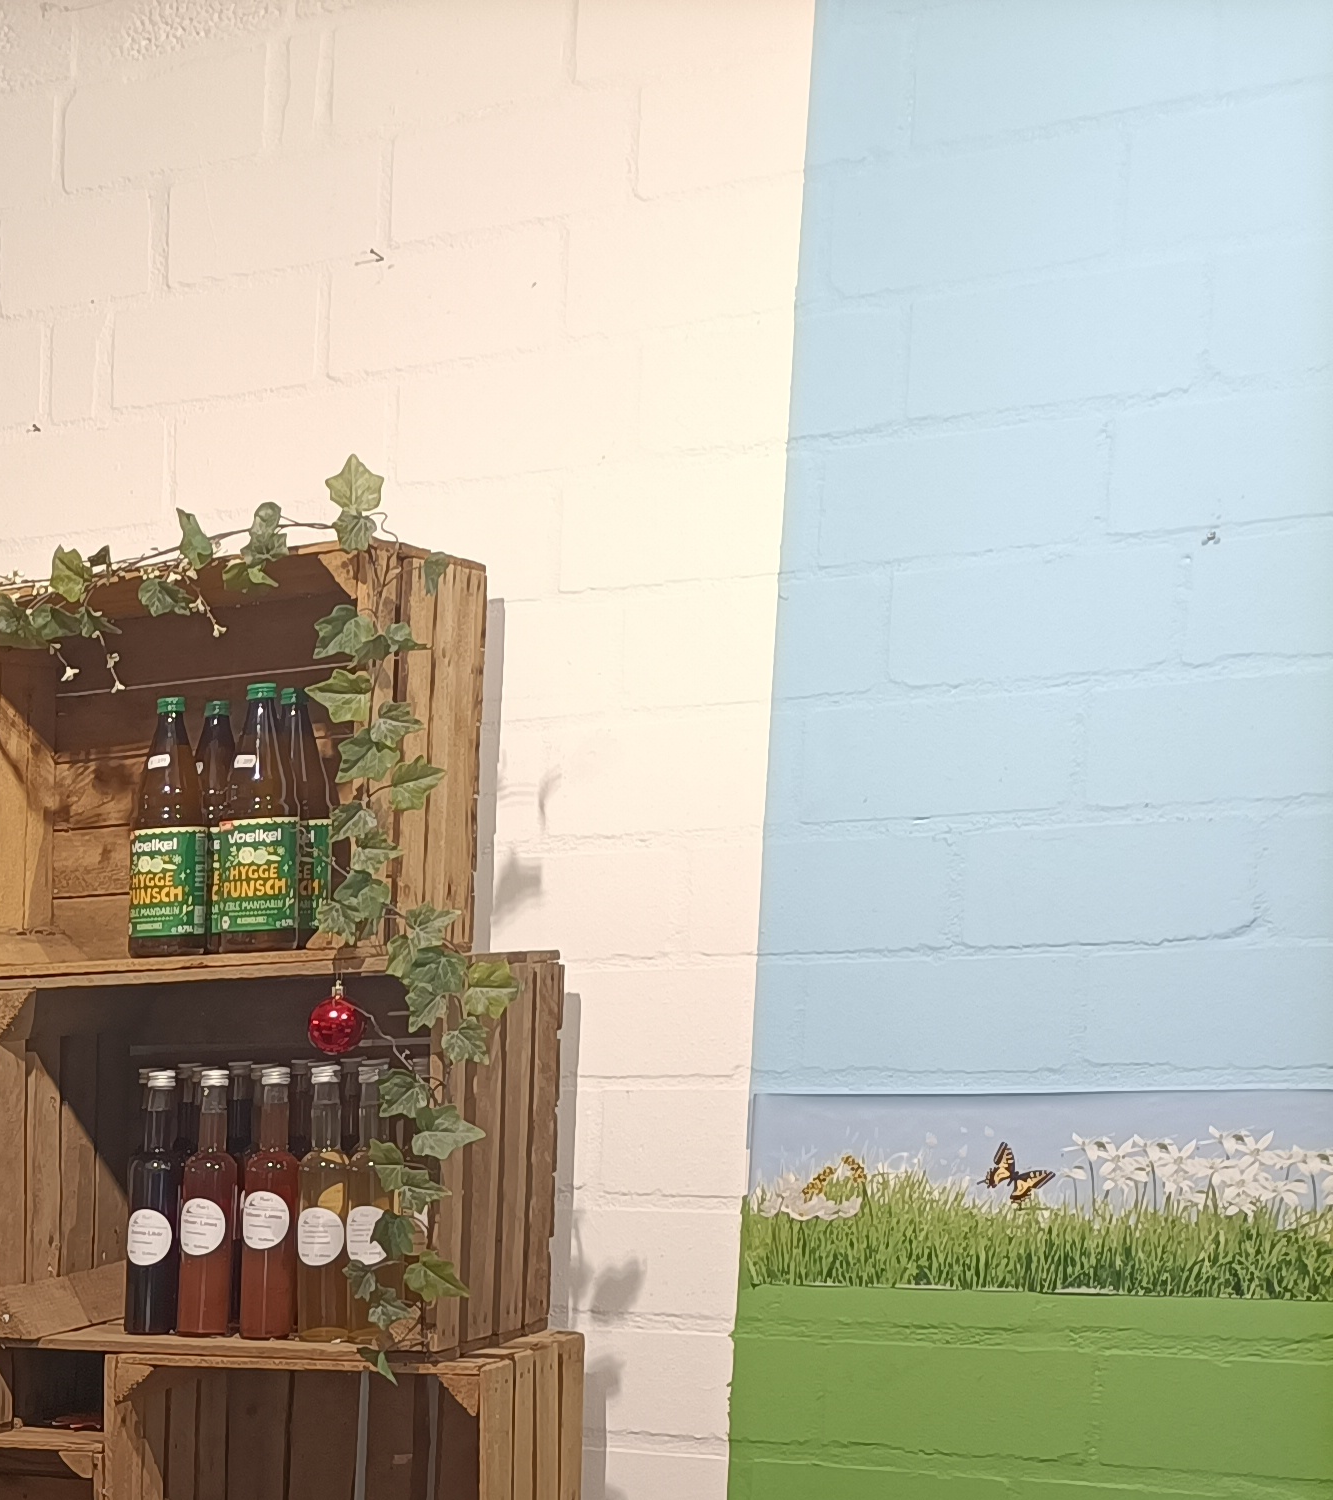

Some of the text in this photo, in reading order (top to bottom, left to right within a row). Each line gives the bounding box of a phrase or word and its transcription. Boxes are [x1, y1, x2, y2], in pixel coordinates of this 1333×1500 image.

[228, 828, 282, 843] Voelkel
[132, 837, 178, 853] Voelkel
[230, 863, 279, 880] HYGGE
[132, 872, 174, 888] HYGGE
[131, 886, 183, 905] UNSCH
[223, 878, 286, 899] PUNSCH
[140, 906, 180, 917] MANDARIN
[241, 899, 283, 910] MANDARIN
